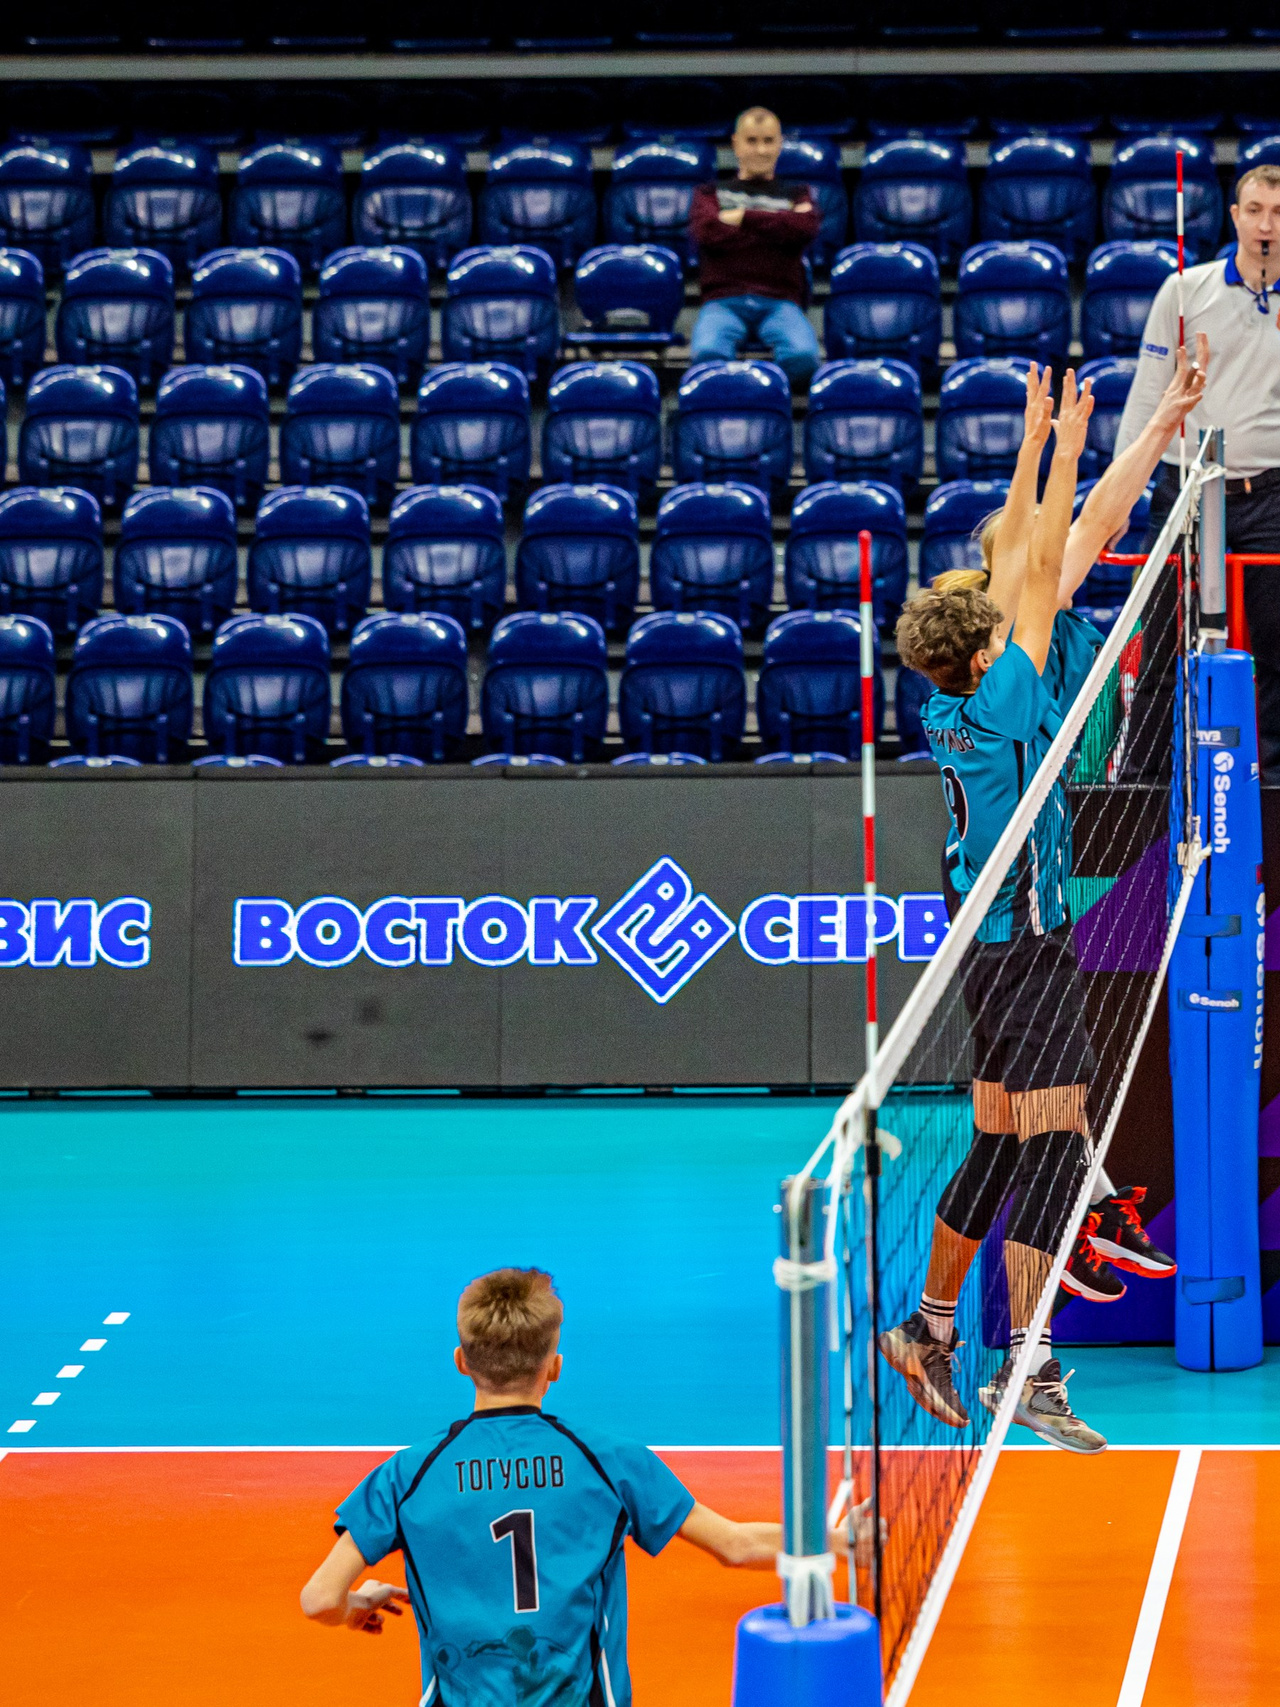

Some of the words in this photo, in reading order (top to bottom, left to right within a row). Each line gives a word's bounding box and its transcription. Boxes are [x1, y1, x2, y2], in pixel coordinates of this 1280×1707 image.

[1213, 774, 1231, 854] Senoh
[232, 893, 599, 968] ВОСТОК
[455, 1455, 564, 1493] ТОГУСОВ
[489, 1508, 540, 1614] 1
